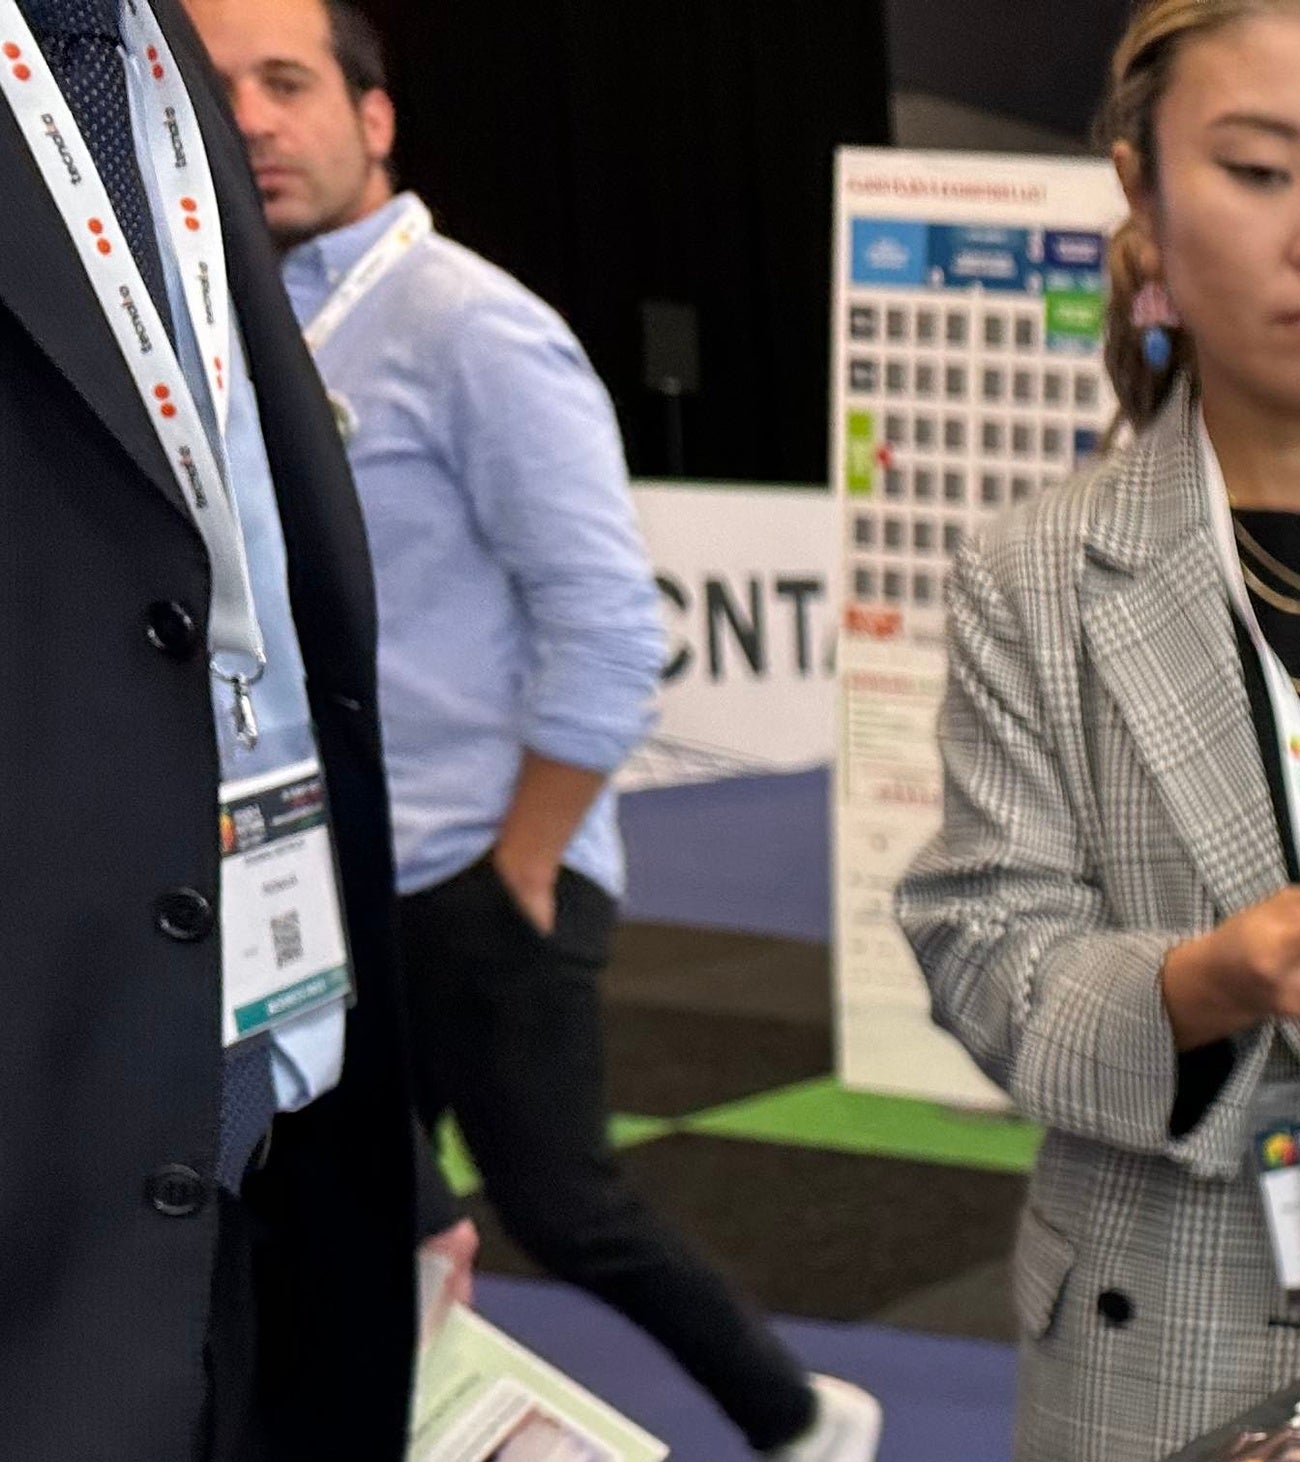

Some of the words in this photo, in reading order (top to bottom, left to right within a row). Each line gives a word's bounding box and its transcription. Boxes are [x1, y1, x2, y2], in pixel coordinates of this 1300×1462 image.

[41, 112, 82, 186] tecnalia
[118, 284, 153, 355] tecnalia
[656, 568, 837, 684] CNT
